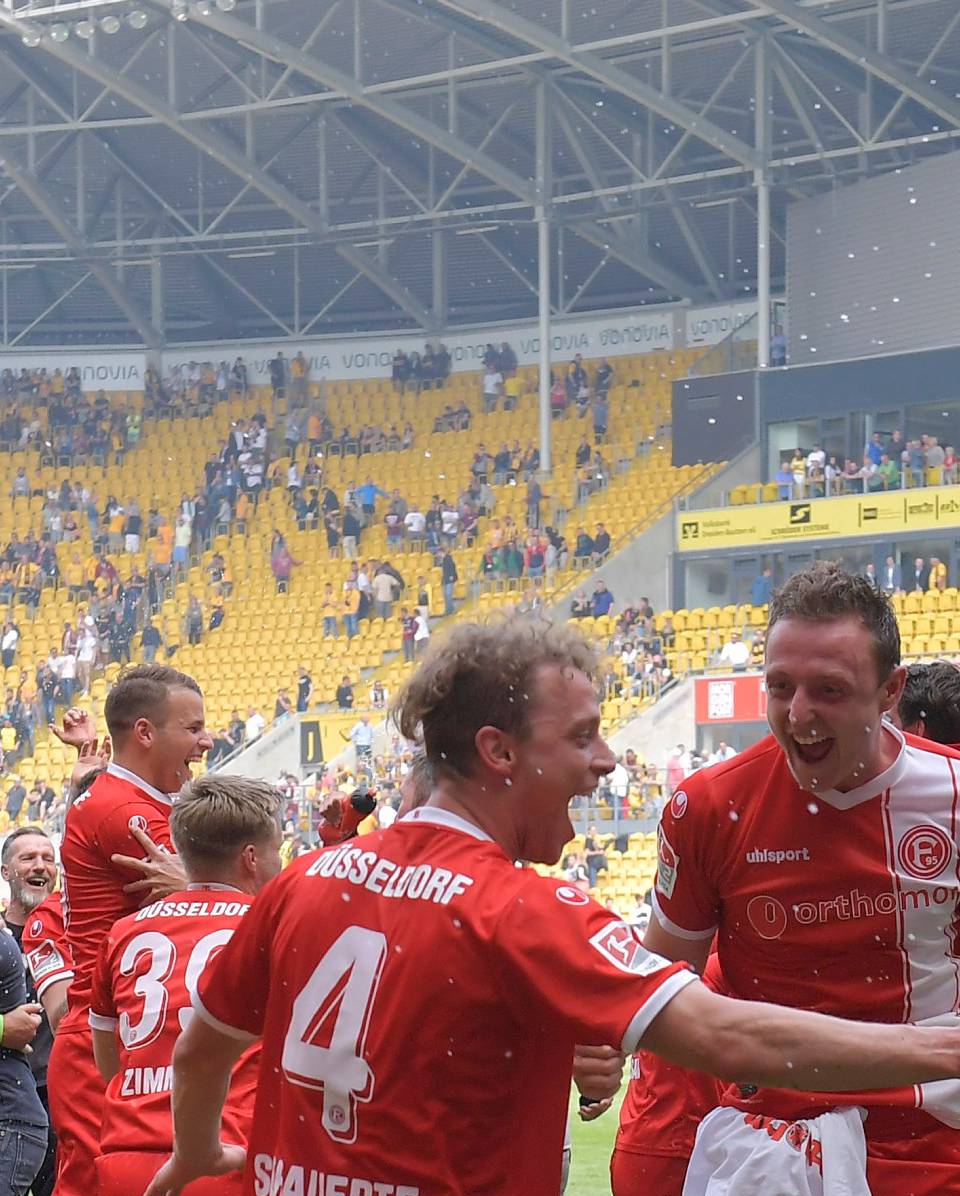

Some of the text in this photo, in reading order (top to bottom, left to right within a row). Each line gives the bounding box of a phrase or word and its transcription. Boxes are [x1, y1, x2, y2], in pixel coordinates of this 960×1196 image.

[305, 842, 474, 905] DÜSSELDORF
[745, 846, 811, 864] uhlsport
[281, 925, 388, 1145] 4
